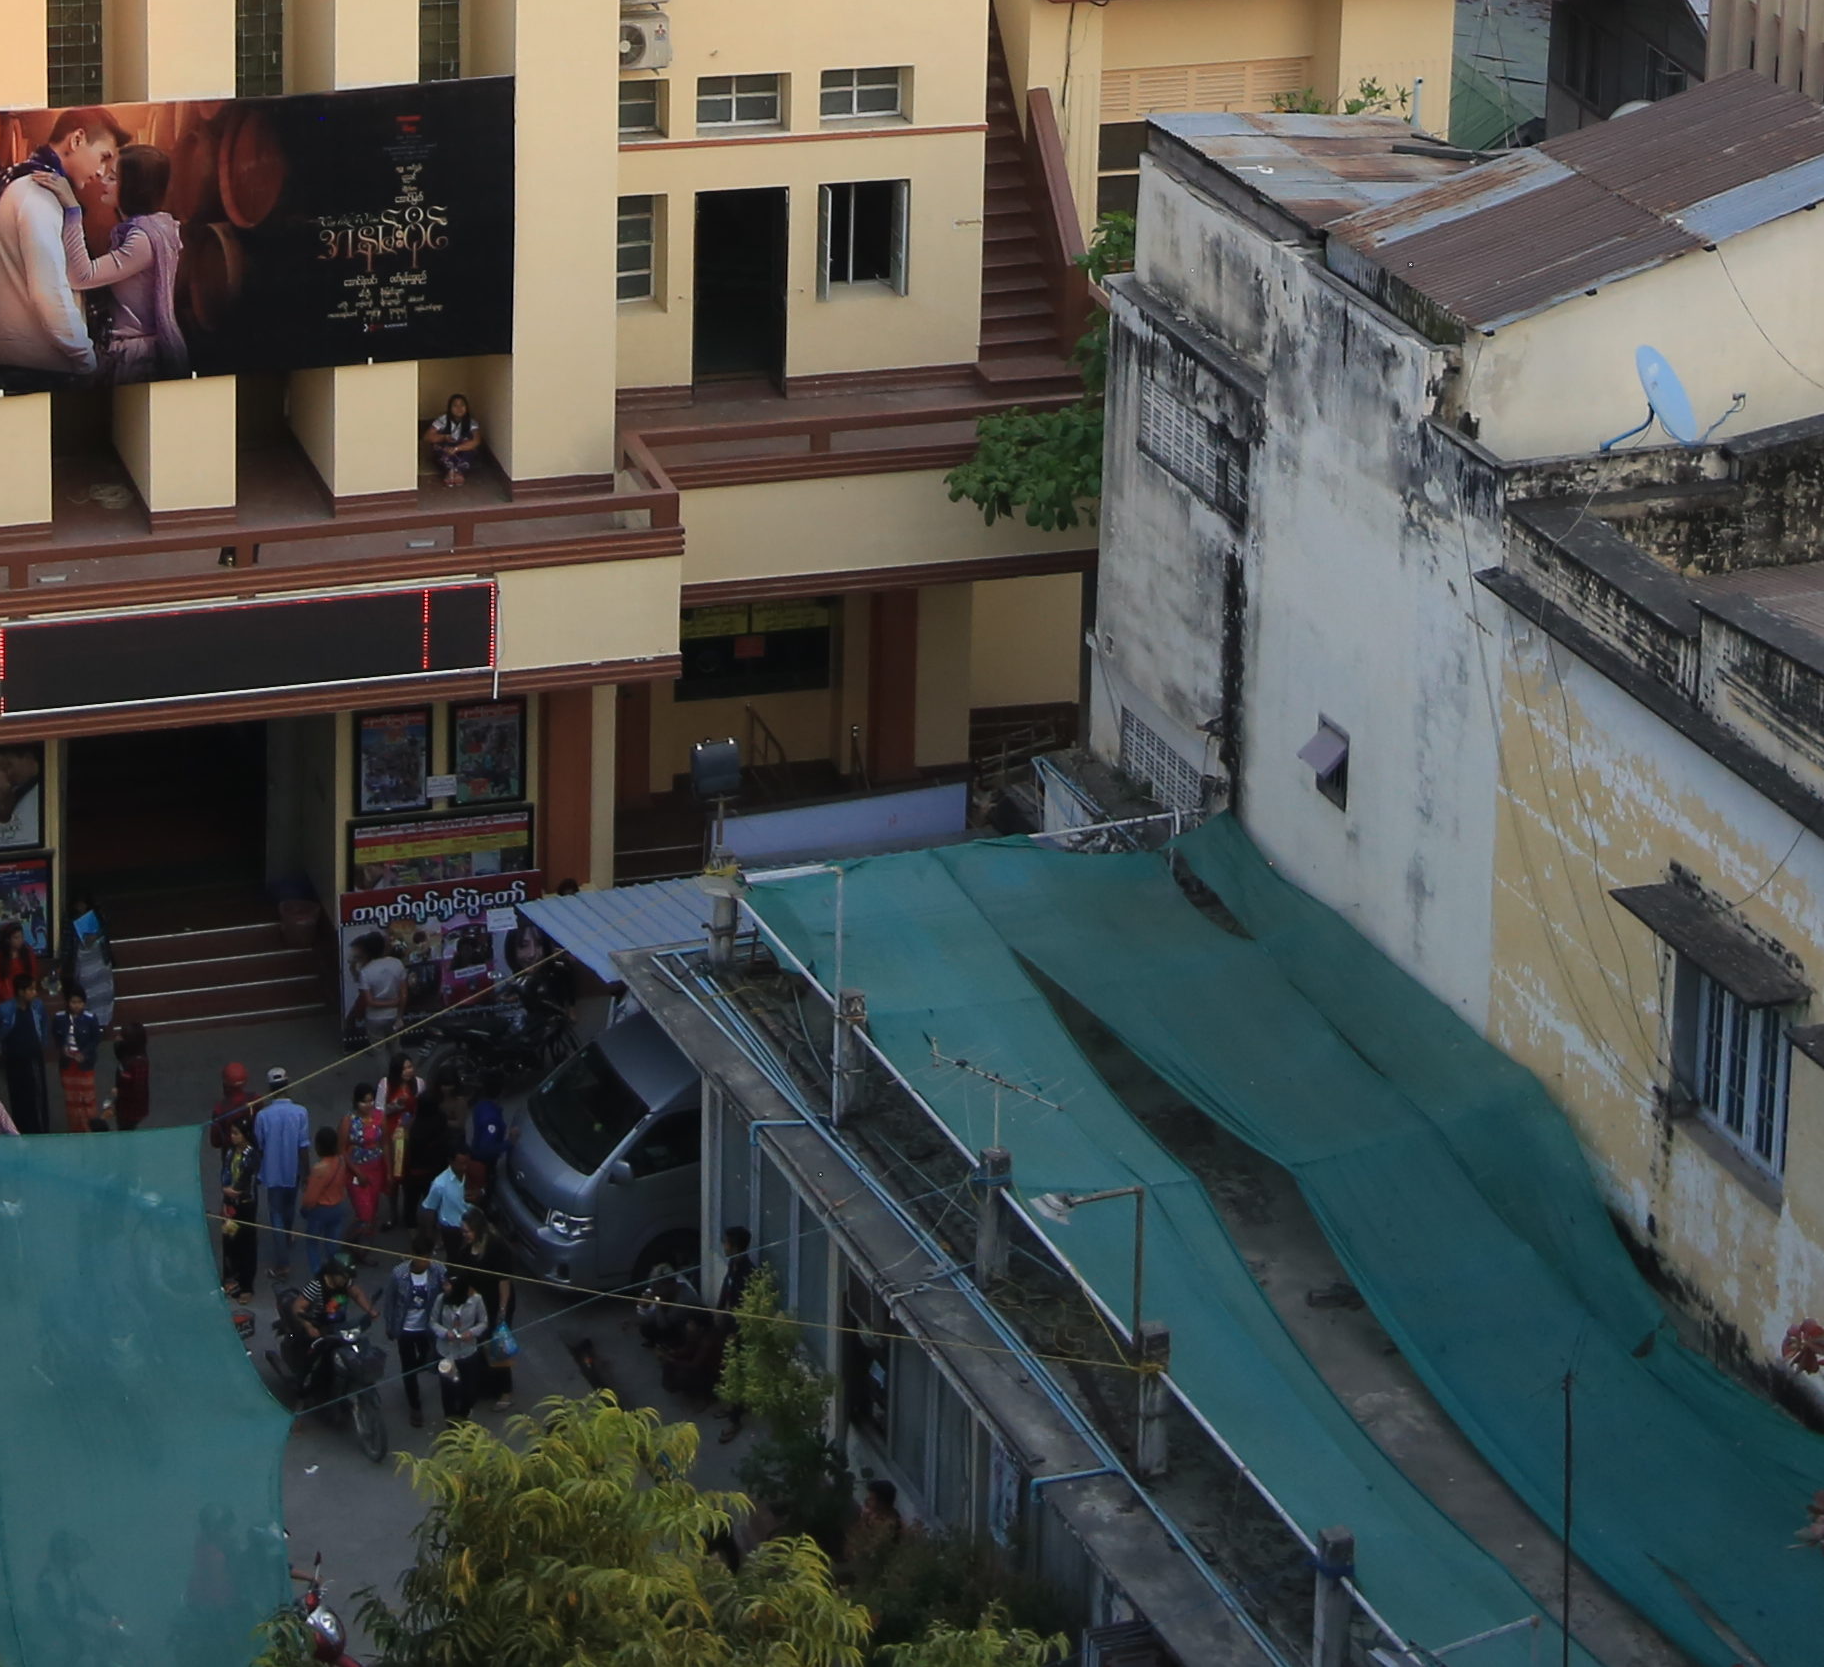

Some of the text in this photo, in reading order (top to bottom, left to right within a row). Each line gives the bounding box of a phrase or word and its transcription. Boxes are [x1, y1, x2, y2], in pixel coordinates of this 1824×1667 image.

[351, 880, 526, 928] တရုတ်ရုပ်ရှင်ပွဲတော်
